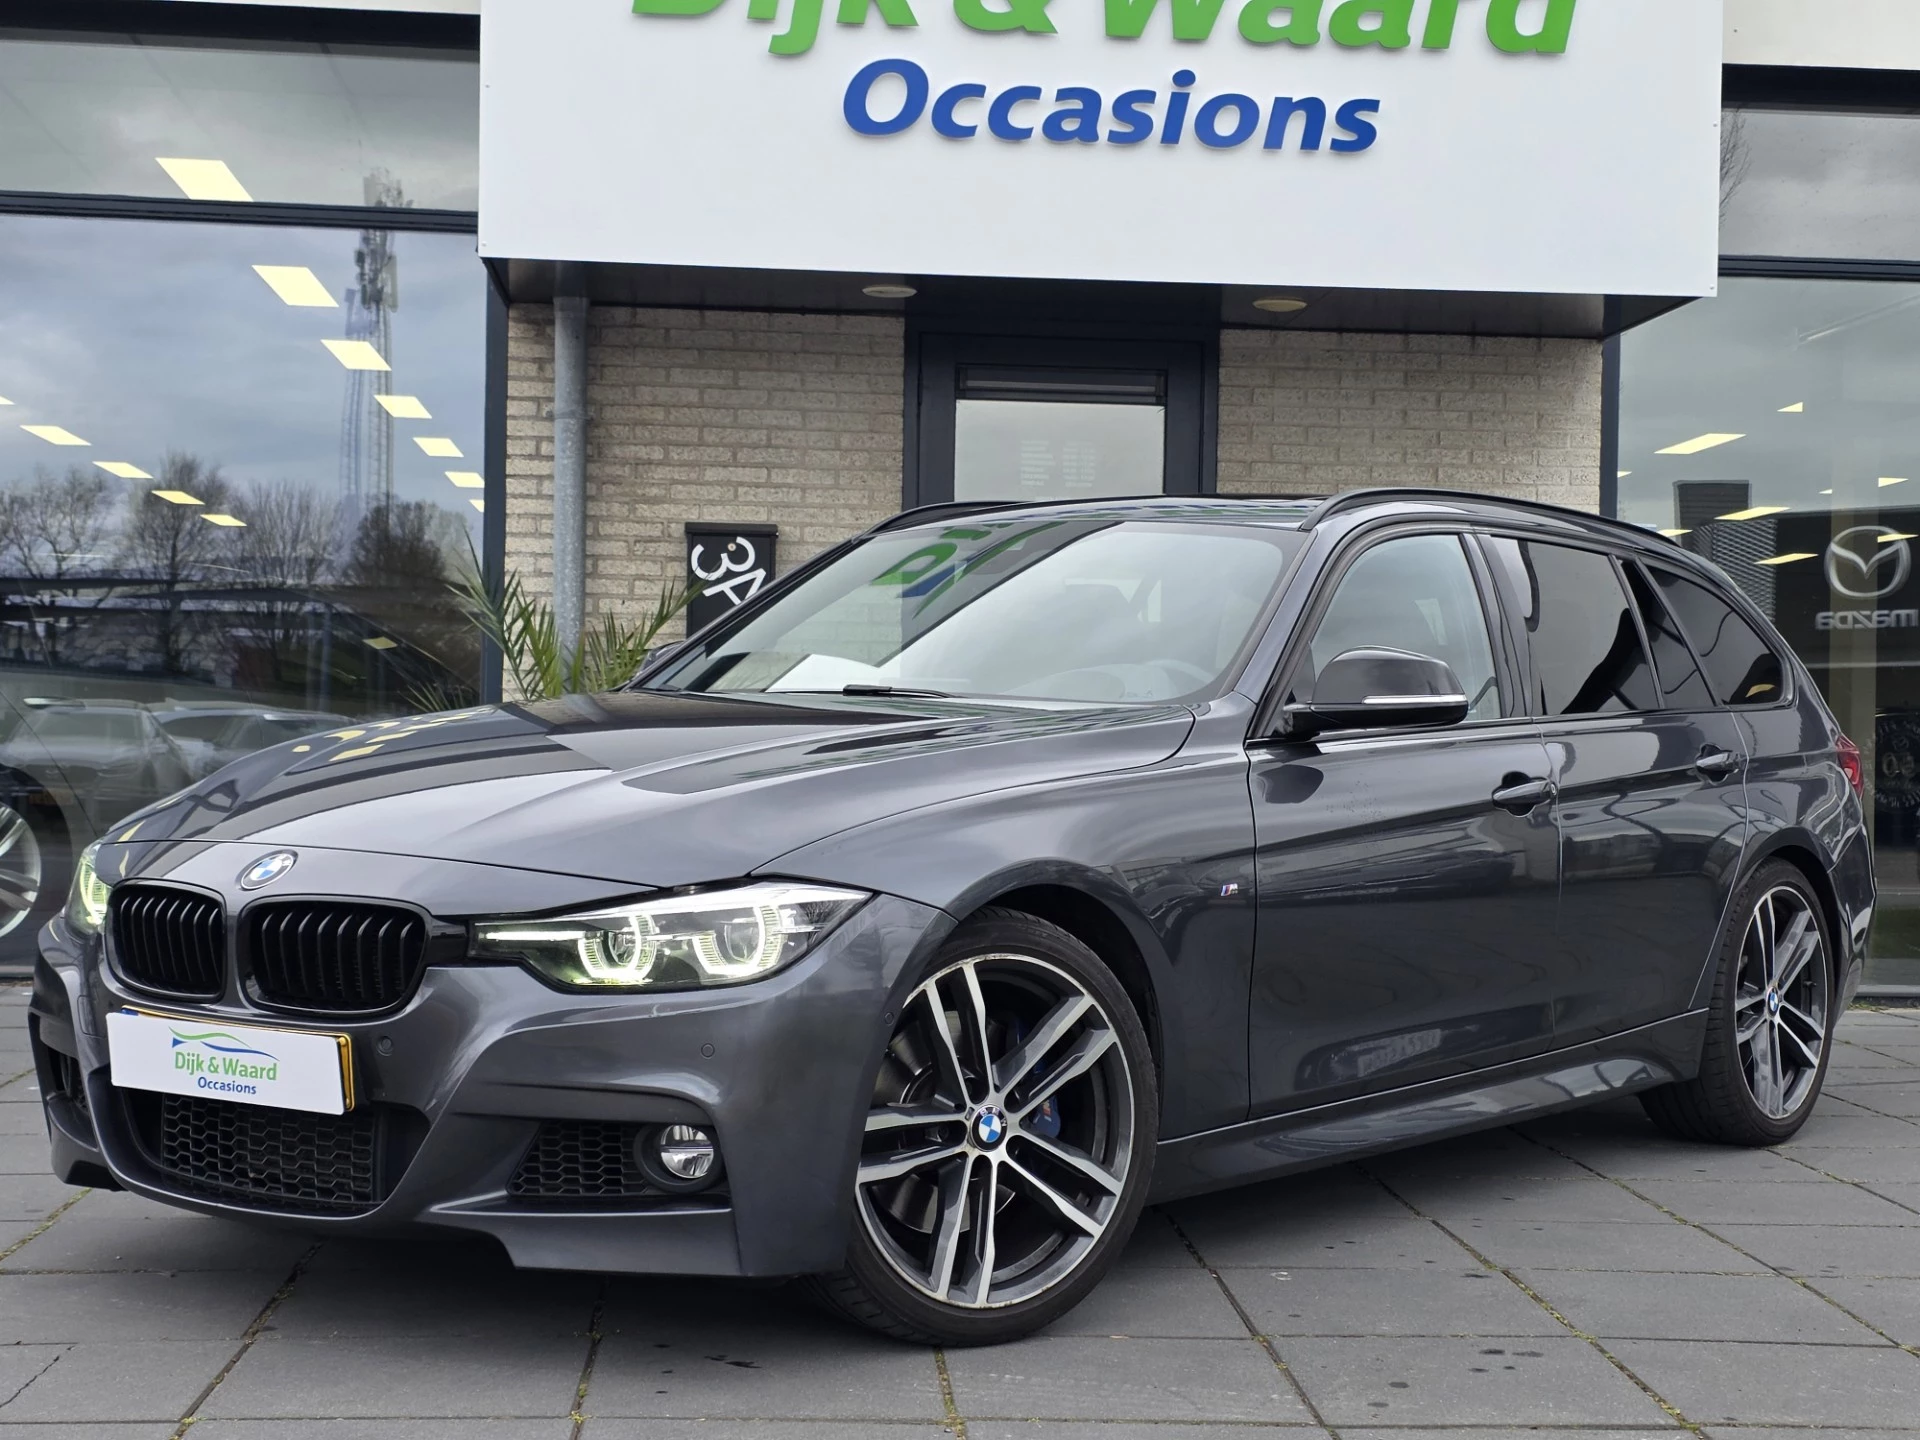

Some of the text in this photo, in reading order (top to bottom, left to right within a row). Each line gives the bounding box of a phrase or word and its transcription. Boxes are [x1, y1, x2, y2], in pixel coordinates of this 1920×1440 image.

[843, 58, 1380, 153] Occasions
[174, 1051, 277, 1081] Dijk & Waard
[197, 1076, 257, 1095] Occasions
